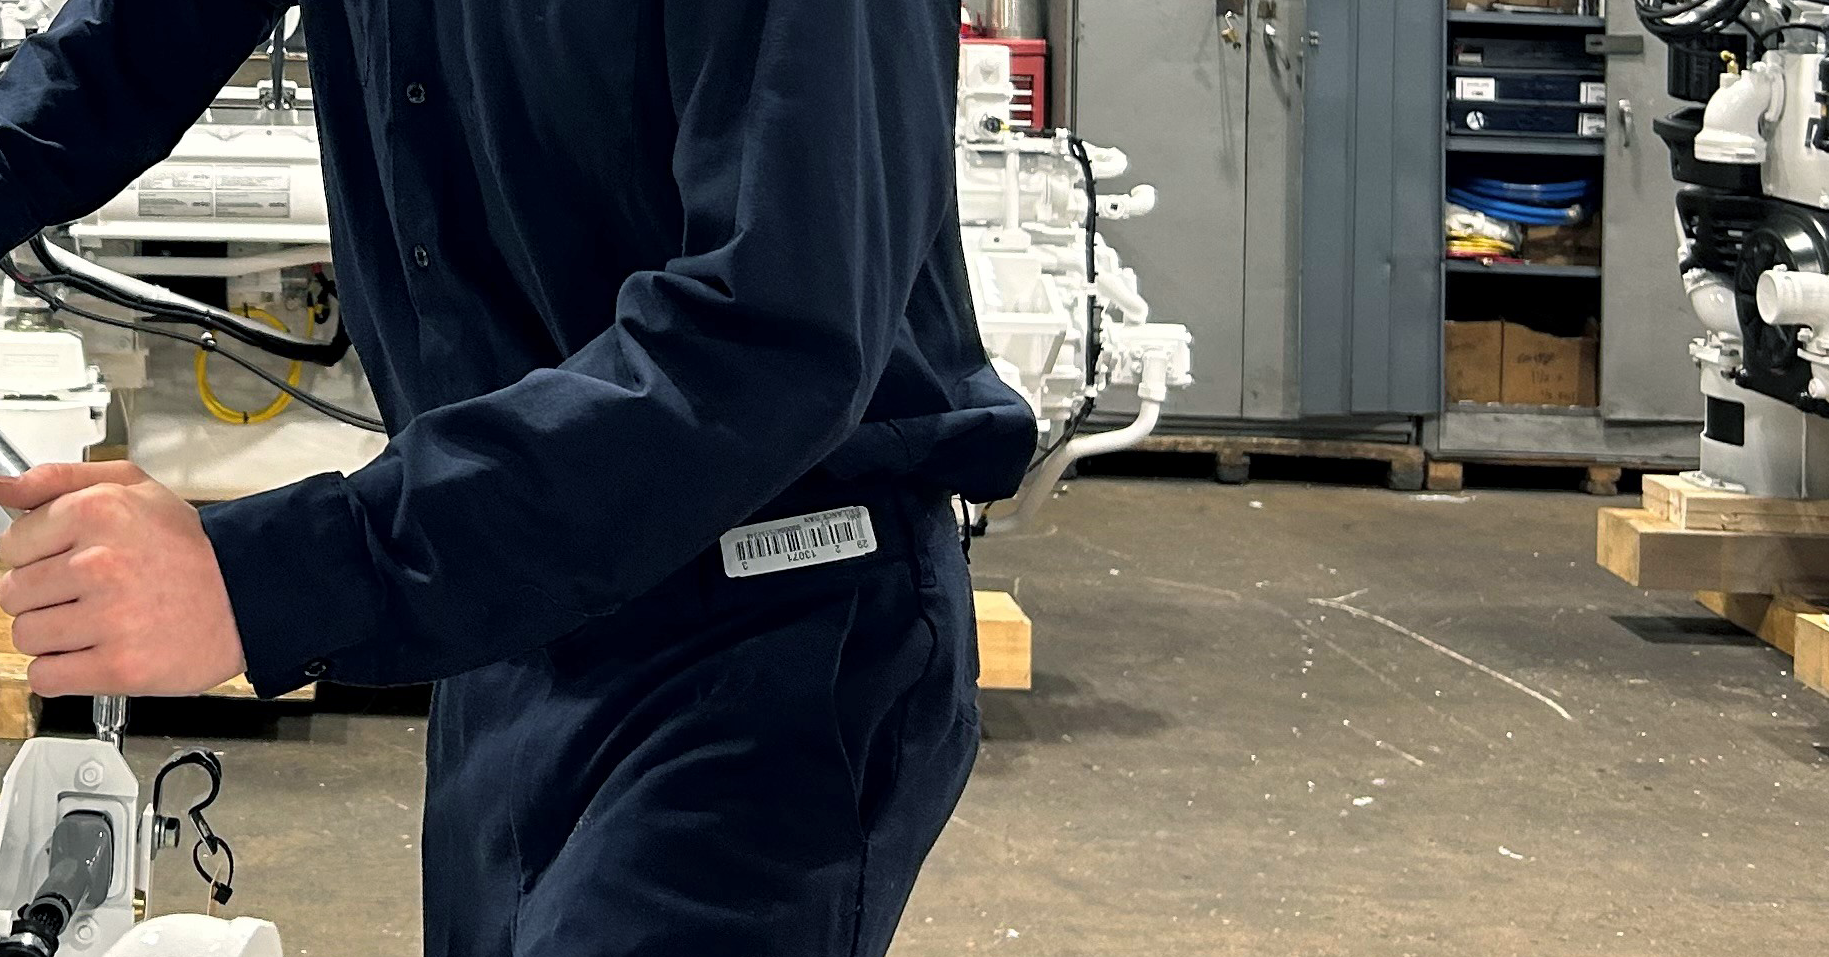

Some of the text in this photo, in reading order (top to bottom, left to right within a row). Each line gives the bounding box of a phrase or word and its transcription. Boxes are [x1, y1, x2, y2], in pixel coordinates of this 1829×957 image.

[834, 544, 841, 554] 2
[786, 549, 817, 563] 13071
[741, 561, 749, 570] 3
